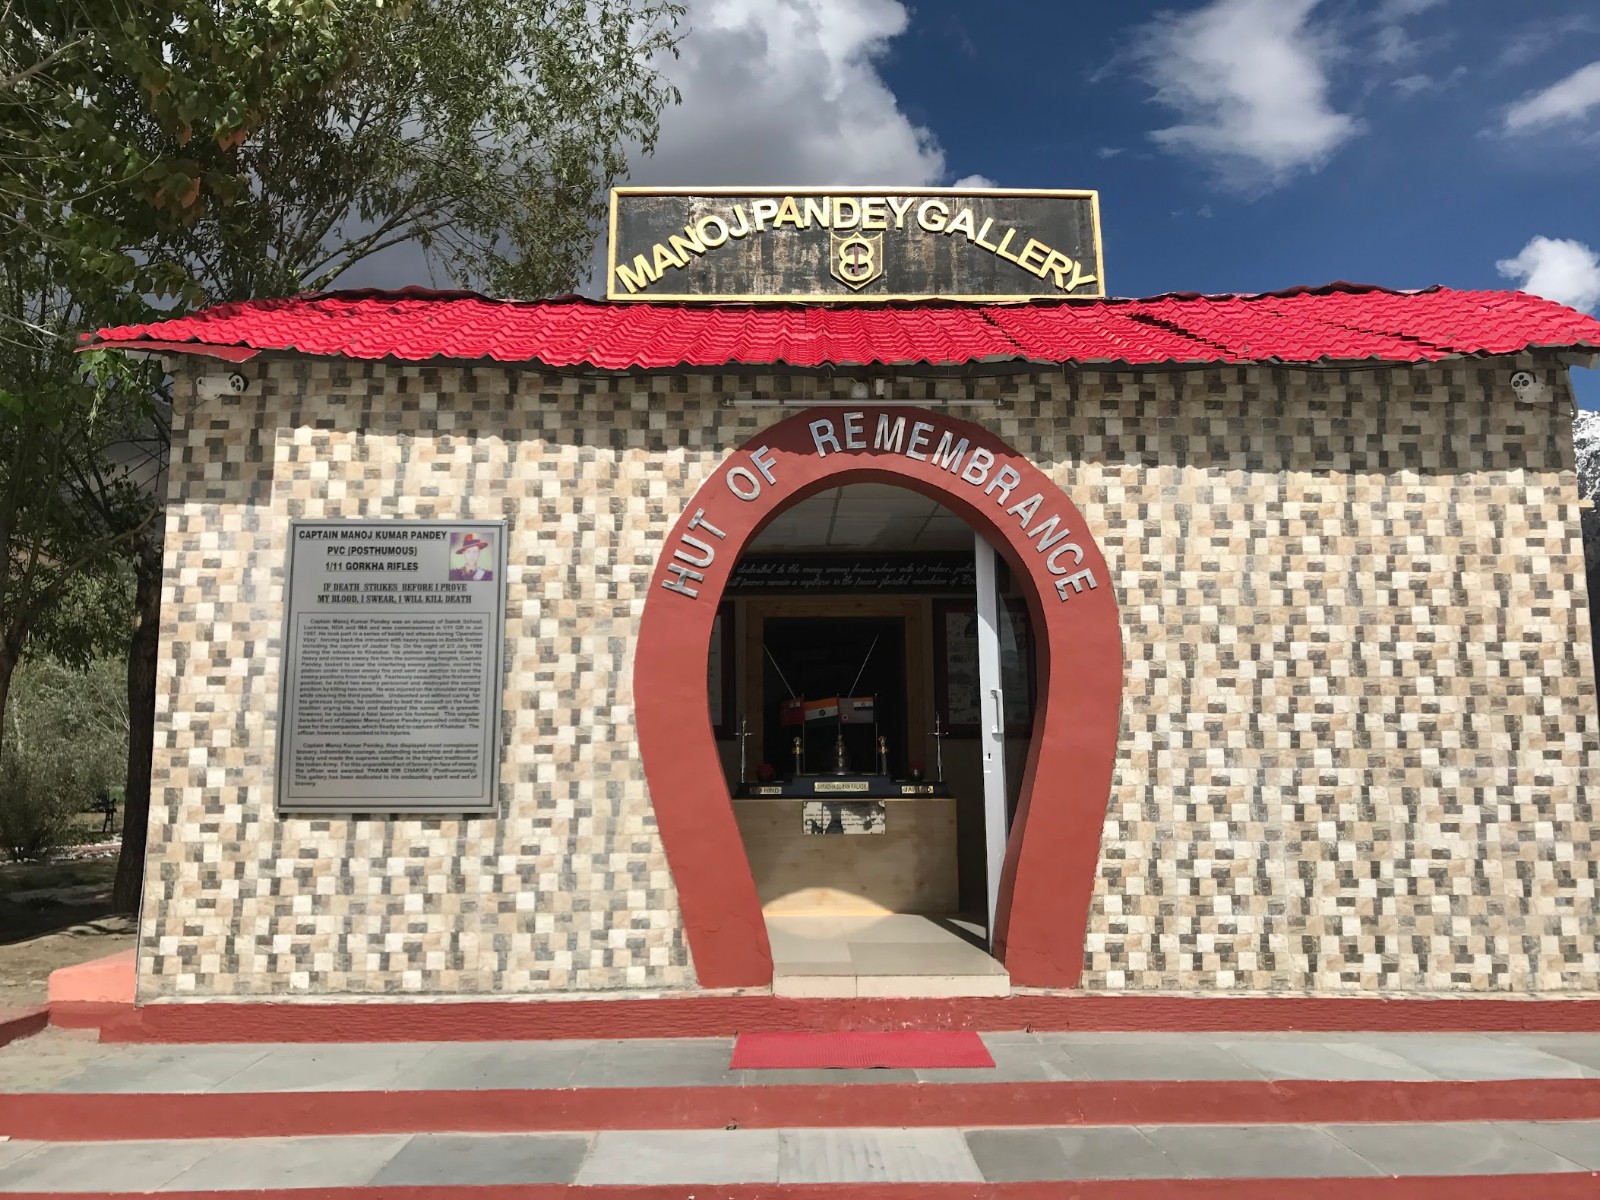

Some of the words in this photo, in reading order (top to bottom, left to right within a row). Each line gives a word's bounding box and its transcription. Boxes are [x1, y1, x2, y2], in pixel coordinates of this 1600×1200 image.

[615, 204, 750, 294] MANOJ
[751, 196, 914, 231] PANDEY
[917, 202, 1097, 293] GALLERY
[661, 508, 726, 599] HUT
[726, 445, 779, 501] OF
[808, 411, 1098, 602] REMEMBRANCE
[299, 531, 338, 540] CAPTAIN
[340, 531, 373, 540] MANOJ
[376, 531, 408, 540] KUMAR
[411, 531, 447, 540] PANDEY
[327, 546, 346, 556] PVC
[348, 546, 418, 556] (POSTHUMOUS)
[325, 562, 343, 571] 1/11
[346, 562, 384, 571] GORKHA
[387, 562, 418, 571] RIFLES
[323, 583, 332, 592] IF
[333, 583, 360, 592] DEATH
[364, 583, 398, 592] STRIKES
[402, 583, 434, 592] BEFORE
[435, 583, 439, 592] I
[440, 583, 467, 592] PROVE
[318, 594, 329, 604] MY
[330, 594, 359, 604] BLOOD,
[360, 594, 364, 604] I
[365, 594, 396, 604] SWEAR,
[398, 594, 402, 604] I
[403, 594, 423, 604] WILL
[425, 594, 444, 604] KILL
[446, 594, 472, 604] DEATH
